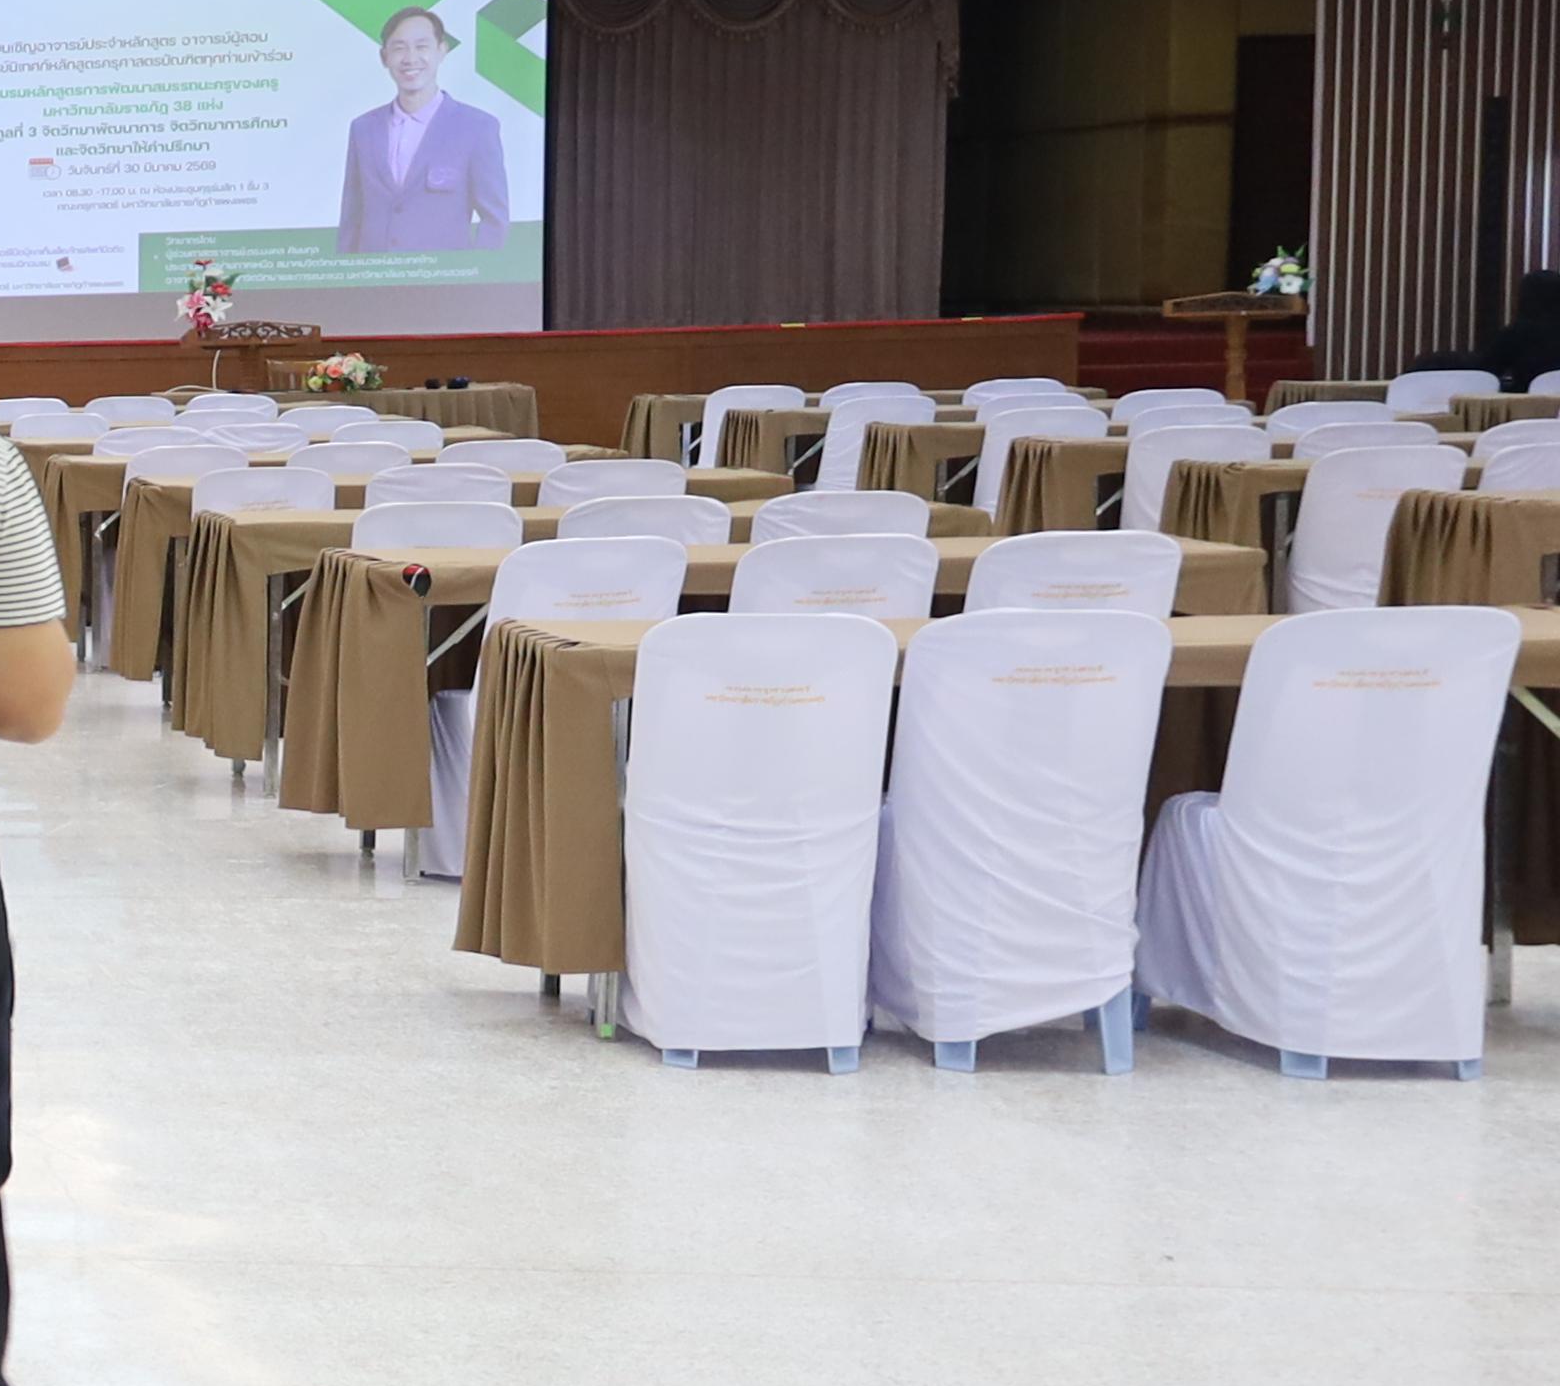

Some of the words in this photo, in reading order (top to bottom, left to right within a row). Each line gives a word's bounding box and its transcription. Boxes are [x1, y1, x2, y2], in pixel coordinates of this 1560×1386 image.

[174, 100, 192, 112] 38
[198, 98, 223, 111] แห่ง
[29, 127, 37, 138] 3
[43, 122, 165, 137] จิตวิทยาพัฒนาการ
[170, 117, 288, 132] จิตวิทยาการศึกษา
[124, 164, 140, 174] 30
